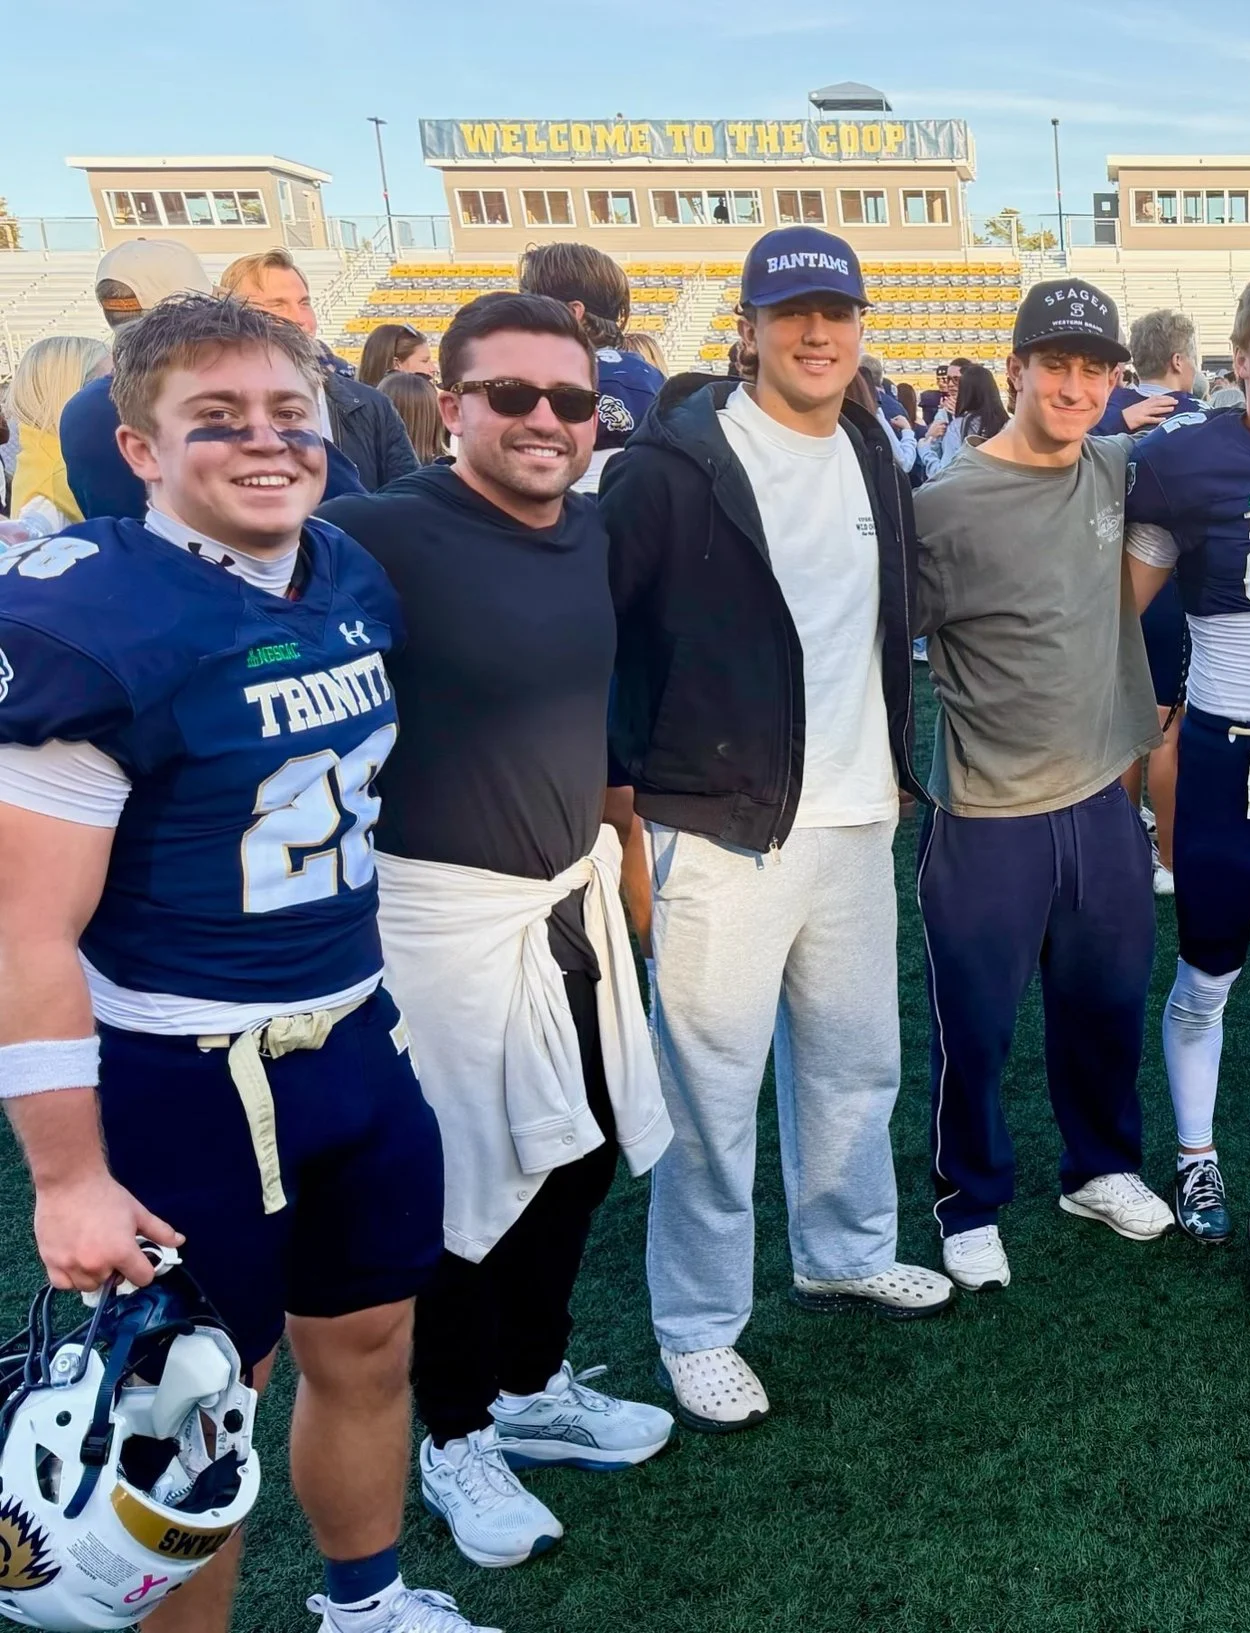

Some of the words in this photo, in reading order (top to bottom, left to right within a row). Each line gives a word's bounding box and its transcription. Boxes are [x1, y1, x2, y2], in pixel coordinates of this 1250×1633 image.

[459, 122, 651, 154] WELCOME
[666, 123, 715, 154] TO
[727, 122, 804, 154] THE
[816, 123, 907, 154] COOP
[767, 252, 849, 275] BANTAMS
[1044, 287, 1109, 316] SEAGER
